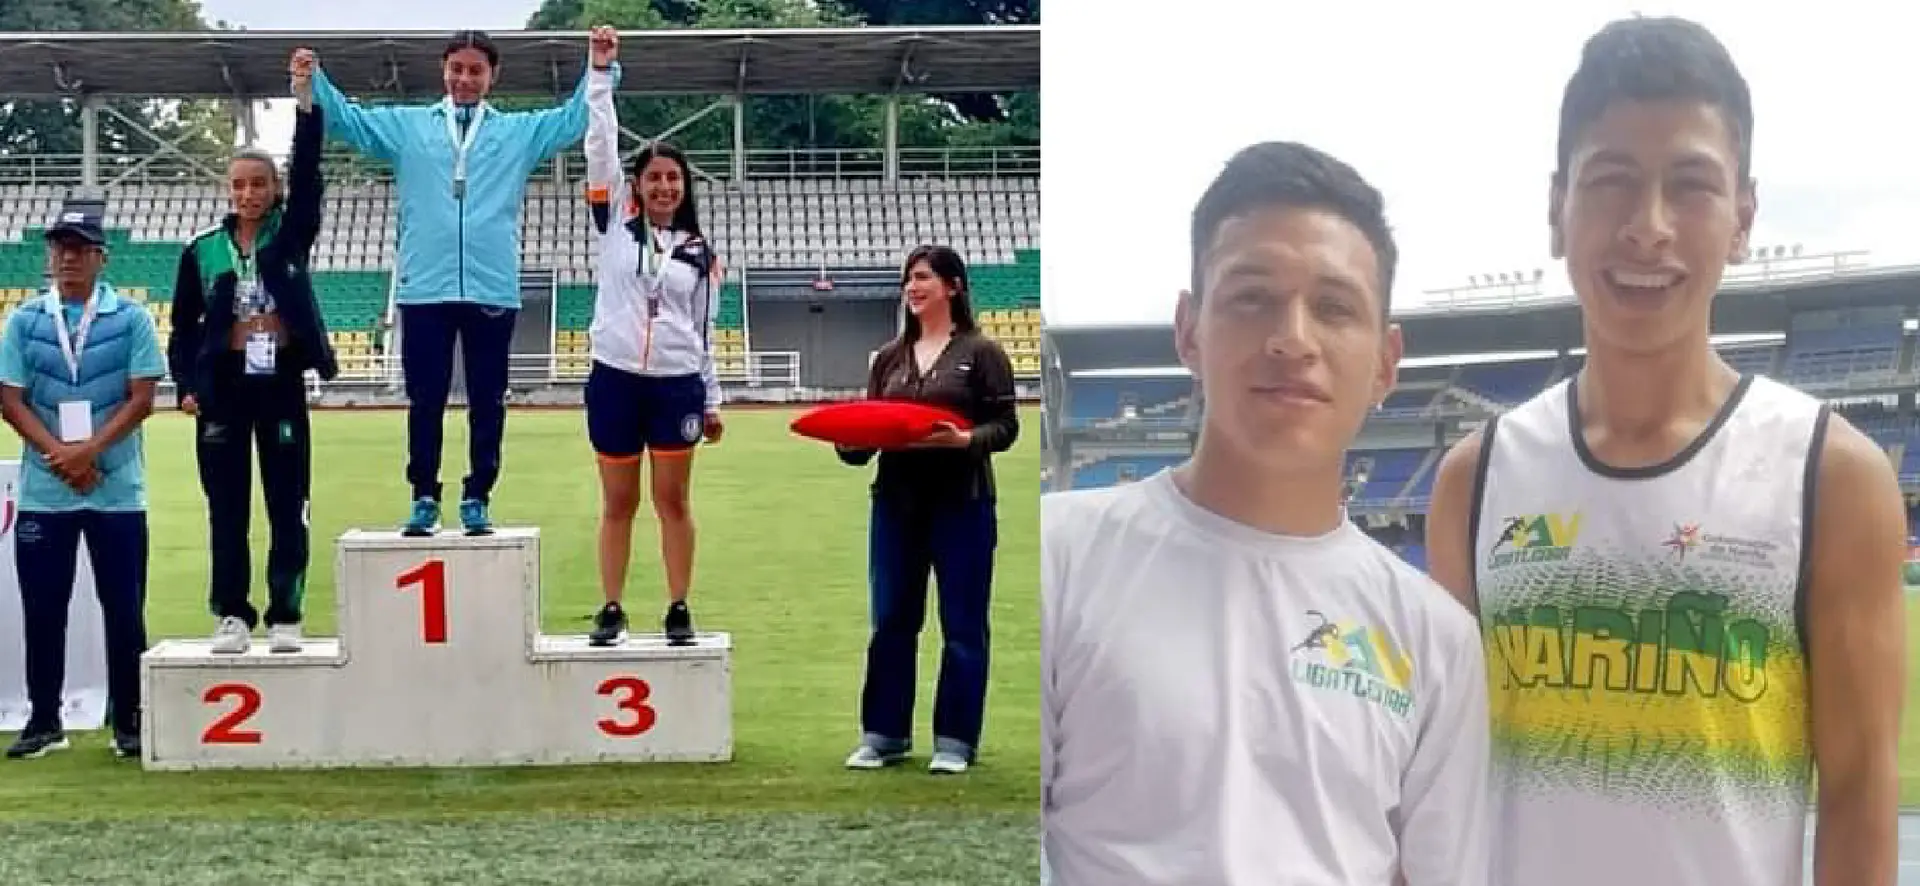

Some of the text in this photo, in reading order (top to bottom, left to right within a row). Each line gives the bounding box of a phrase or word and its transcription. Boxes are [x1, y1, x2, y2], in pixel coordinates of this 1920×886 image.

[396, 560, 447, 644] 1
[1494, 589, 1769, 703] NARIÑO
[202, 684, 262, 744] 2
[597, 676, 657, 737] 3
